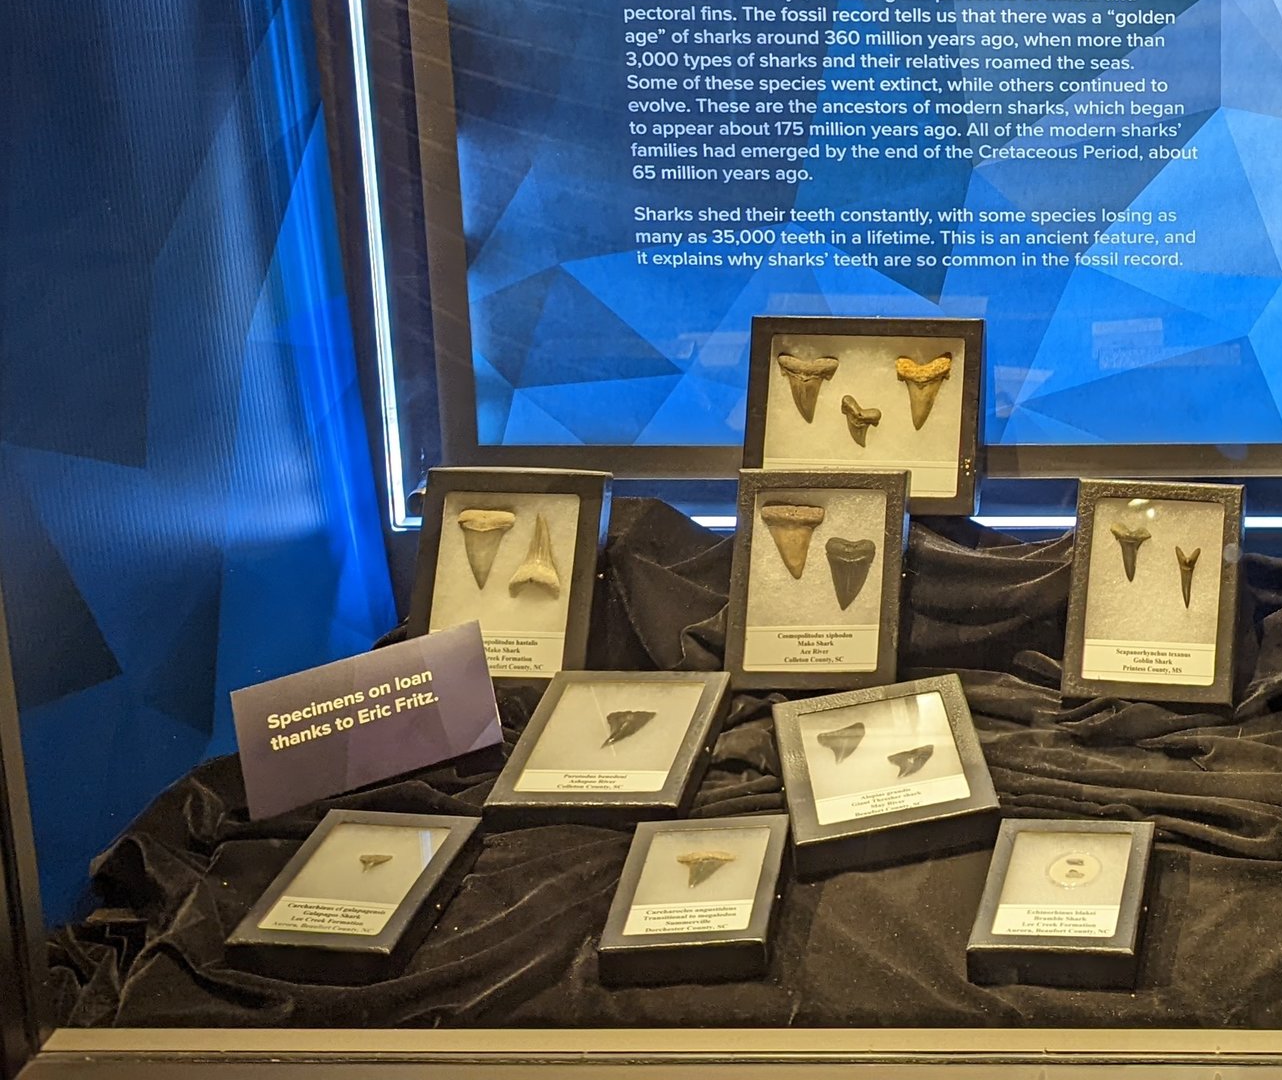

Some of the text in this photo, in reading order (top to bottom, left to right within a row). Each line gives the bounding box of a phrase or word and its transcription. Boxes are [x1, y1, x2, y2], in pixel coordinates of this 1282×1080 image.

[267, 670, 432, 729] Specimens on loan
[270, 691, 439, 750] thanks to Eric Fritz.
